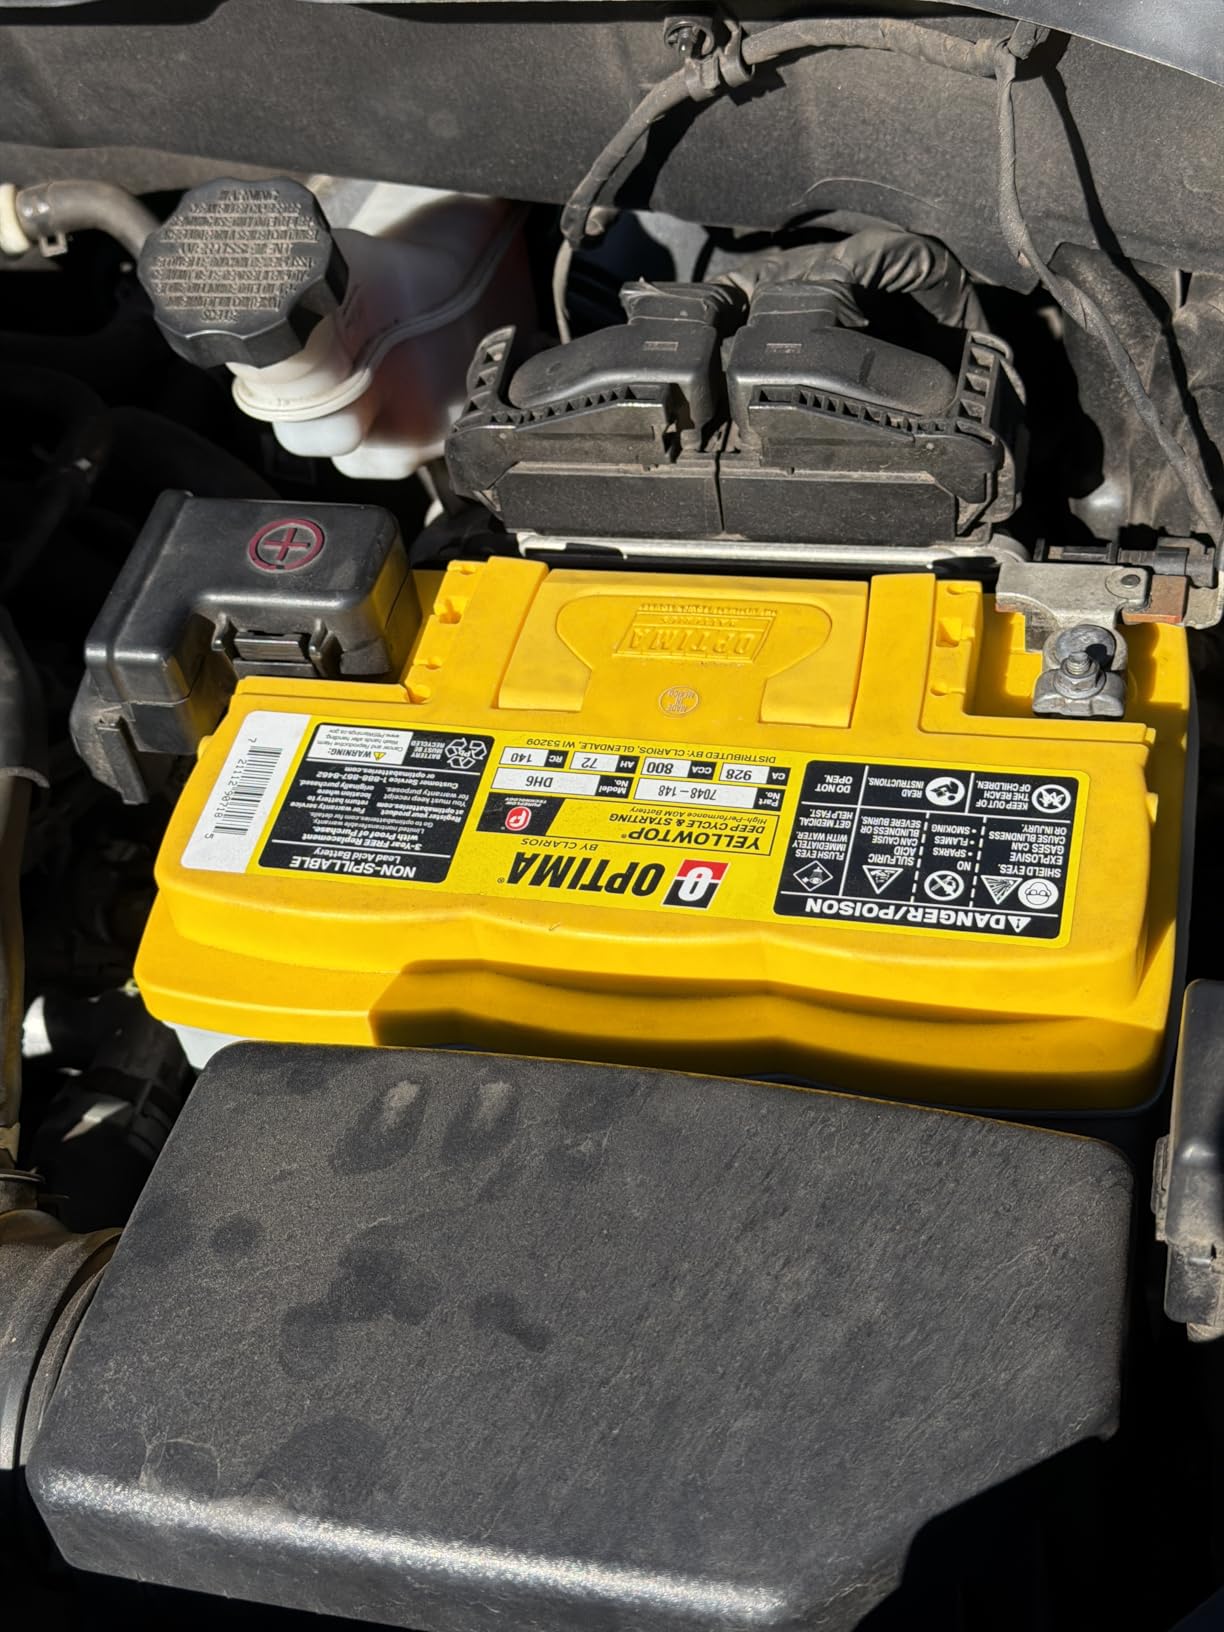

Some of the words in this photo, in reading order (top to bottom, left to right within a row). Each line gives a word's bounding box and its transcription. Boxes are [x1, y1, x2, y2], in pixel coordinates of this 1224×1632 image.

[629, 627, 756, 655] OPTIMA
[410, 740, 445, 748] RECYCLED
[526, 738, 560, 747] 53209
[561, 740, 575, 748] WI
[579, 741, 634, 752] GLENDALE,
[327, 748, 371, 757] WARNING:
[410, 751, 441, 759] BATTERY
[458, 748, 472, 757] Pb
[637, 745, 685, 756] CLARIOS,
[510, 752, 531, 762] 140
[705, 751, 776, 763] DISTRIBUTED
[580, 757, 597, 768] 72
[619, 760, 634, 768] AH
[646, 761, 673, 774] 800
[227, 758, 247, 786] 21112
[691, 765, 712, 774] CCA
[725, 768, 751, 780] 928
[388, 776, 418, 785] Service
[525, 775, 553, 787] DH6
[771, 772, 785, 780] CA
[824, 774, 852, 784] OPEN.
[339, 781, 374, 790] originally
[419, 779, 458, 789] Customer
[614, 779, 628, 787] No.
[814, 783, 835, 792] NOT
[868, 777, 924, 788] INSTRUCTIONS.
[976, 780, 1019, 791] CHILDREN.
[1018, 783, 1031, 792] OF
[316, 788, 340, 796] where
[422, 788, 456, 798] warranty
[598, 785, 626, 794] Model
[836, 784, 851, 793] DO
[901, 788, 922, 798] READ
[315, 794, 344, 804] battery
[340, 790, 371, 799] location
[383, 792, 410, 800] receipt
[410, 794, 430, 804] keep
[457, 793, 469, 801] for
[765, 791, 780, 800] No.
[983, 790, 1012, 800] REACH
[1012, 792, 1029, 801] THE
[213, 790, 233, 817] 90718
[317, 802, 351, 811] warranty
[451, 799, 466, 807] You
[758, 798, 779, 807] Part
[975, 798, 987, 807] OF
[987, 799, 1005, 809] OUT
[1005, 801, 1028, 810] KEEP
[351, 806, 365, 814] For
[380, 808, 411, 816] product
[410, 810, 428, 818] your
[629, 805, 662, 815] Battery
[809, 809, 831, 818] FAST.
[831, 810, 853, 819] HELP
[428, 813, 461, 822] Register
[609, 813, 672, 825] STARTING
[675, 818, 685, 826] &
[686, 812, 767, 824] High-Performance
[799, 816, 834, 827] MEDICAL
[861, 815, 889, 826] BURNS.
[686, 819, 728, 830] CYCLE
[834, 819, 851, 828] GET
[888, 818, 921, 828] SEVERE
[312, 825, 358, 836] Purchase.
[357, 829, 369, 837] of
[397, 826, 424, 834] Limited
[729, 823, 765, 834] DEEP
[859, 825, 872, 834] OR
[873, 826, 919, 837] BLINDNESS
[931, 823, 970, 834] SMOKING
[1021, 824, 1053, 834] INJURY.
[1053, 826, 1067, 835] OR
[301, 833, 363, 845] Replacement
[369, 831, 396, 840] Proof
[396, 833, 418, 841] with
[796, 831, 825, 840] WATER.
[826, 833, 847, 842] WITH
[871, 834, 899, 845] CAUSE
[934, 835, 968, 846] FLAMES
[988, 830, 1036, 842] BLINDNESS
[1036, 834, 1065, 844] CAUSE
[363, 838, 390, 847] FREE
[390, 841, 422, 850] 3-Year
[520, 837, 577, 849] CLARIOS
[792, 839, 846, 851] IMMEDIATELY
[899, 837, 918, 846] CAN
[1011, 841, 1029, 851] CAN
[580, 843, 598, 851] BY
[893, 845, 916, 856] ACID
[932, 847, 966, 857] SPARKS
[1031, 843, 1064, 854] GASES
[313, 846, 351, 859] Battery
[351, 851, 375, 861] Acid
[795, 848, 817, 858] EYES
[817, 850, 844, 860] FLUSH
[374, 853, 400, 863] Lead
[867, 853, 914, 865] SULFURIC
[1009, 851, 1062, 865] EXPLOSIVE
[290, 856, 415, 877] NON-SPILLABLE
[956, 860, 971, 871] NO
[998, 863, 1025, 875] EYES.
[1026, 866, 1061, 877] SHIELD
[806, 898, 1005, 928] DANGER/POISON
